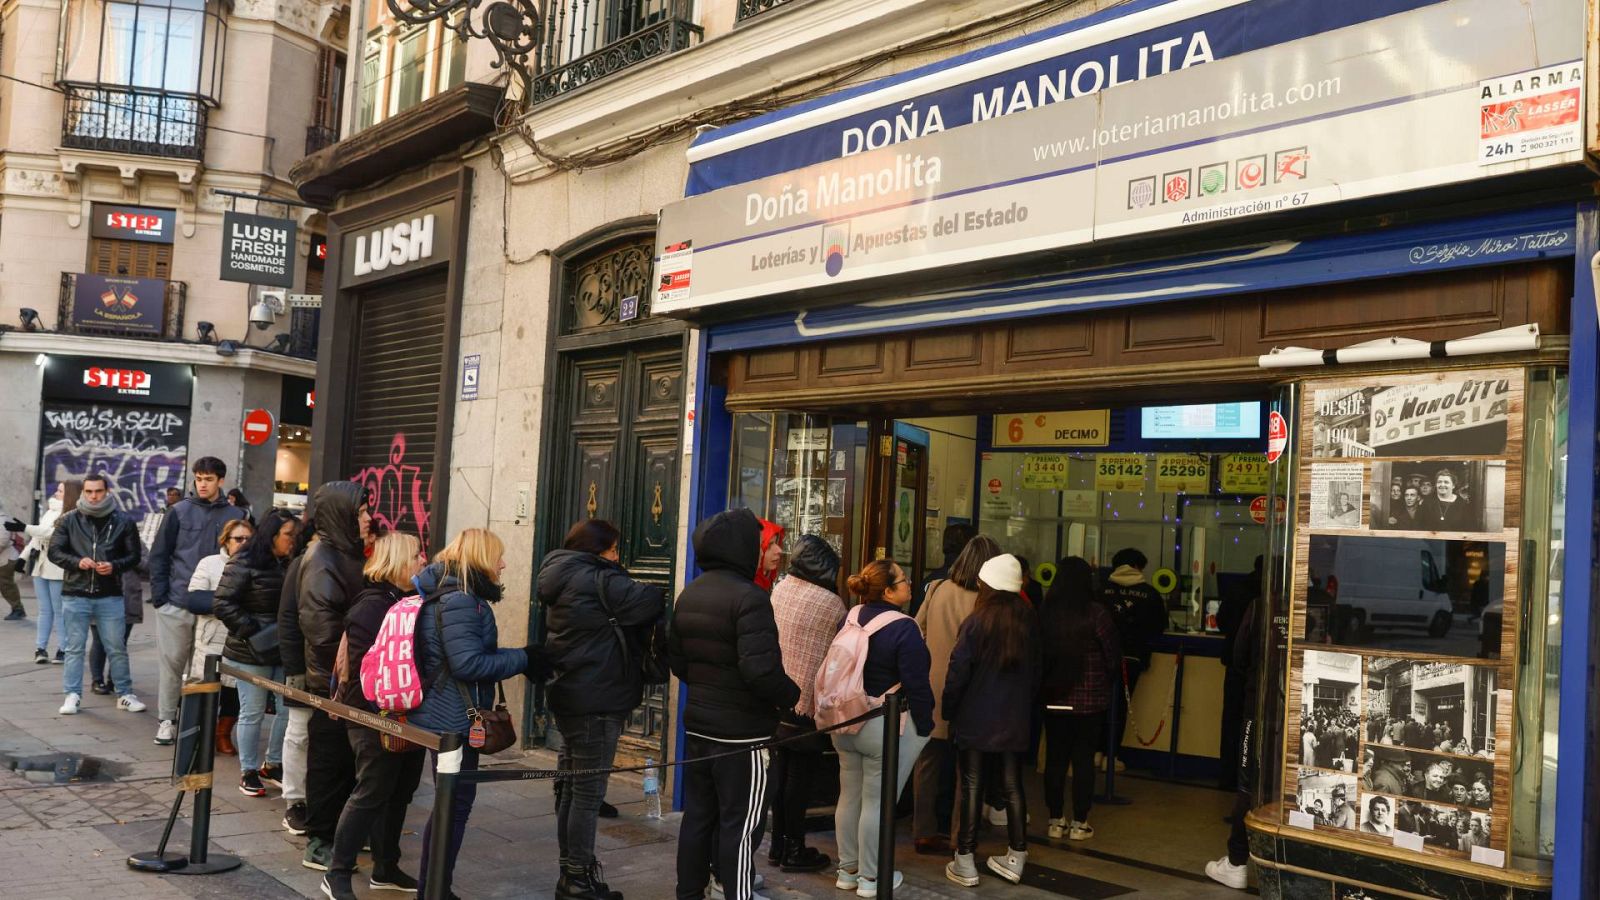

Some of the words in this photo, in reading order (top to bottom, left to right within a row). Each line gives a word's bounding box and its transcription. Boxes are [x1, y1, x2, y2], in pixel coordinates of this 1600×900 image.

[1481, 68, 1581, 99] ALARMA
[841, 101, 946, 158] DOÑA
[972, 30, 1214, 124] MANOLITA
[1528, 98, 1576, 116] LASSER
[1033, 77, 1341, 161] www.loteriamanolita.com
[1486, 142, 1513, 157] 24h
[745, 184, 808, 226] Doña
[816, 153, 942, 210] Manolita
[1182, 202, 1270, 224] Administración
[1292, 192, 1309, 207] 67
[111, 211, 158, 230] STEP
[232, 223, 287, 244] LUSH
[751, 246, 806, 272] Loterías
[809, 246, 818, 265] y
[853, 223, 927, 255] Apuestas
[933, 213, 959, 237] del
[964, 202, 1028, 232] Estado
[231, 238, 286, 257] FRESH
[354, 214, 434, 276] LUSH
[230, 251, 286, 266] HANDMADE
[230, 261, 285, 275] COSMETICS
[622, 301, 634, 316] 22
[86, 366, 146, 389] STEP
[1320, 398, 1366, 417] DESDE
[1008, 417, 1024, 443] 6
[1034, 414, 1046, 428] €
[1373, 399, 1508, 444] LOTERIA
[1055, 429, 1099, 440] DECIMO
[1027, 463, 1064, 472] 13440
[1099, 465, 1143, 476] 36142
[1160, 465, 1206, 476] 25296
